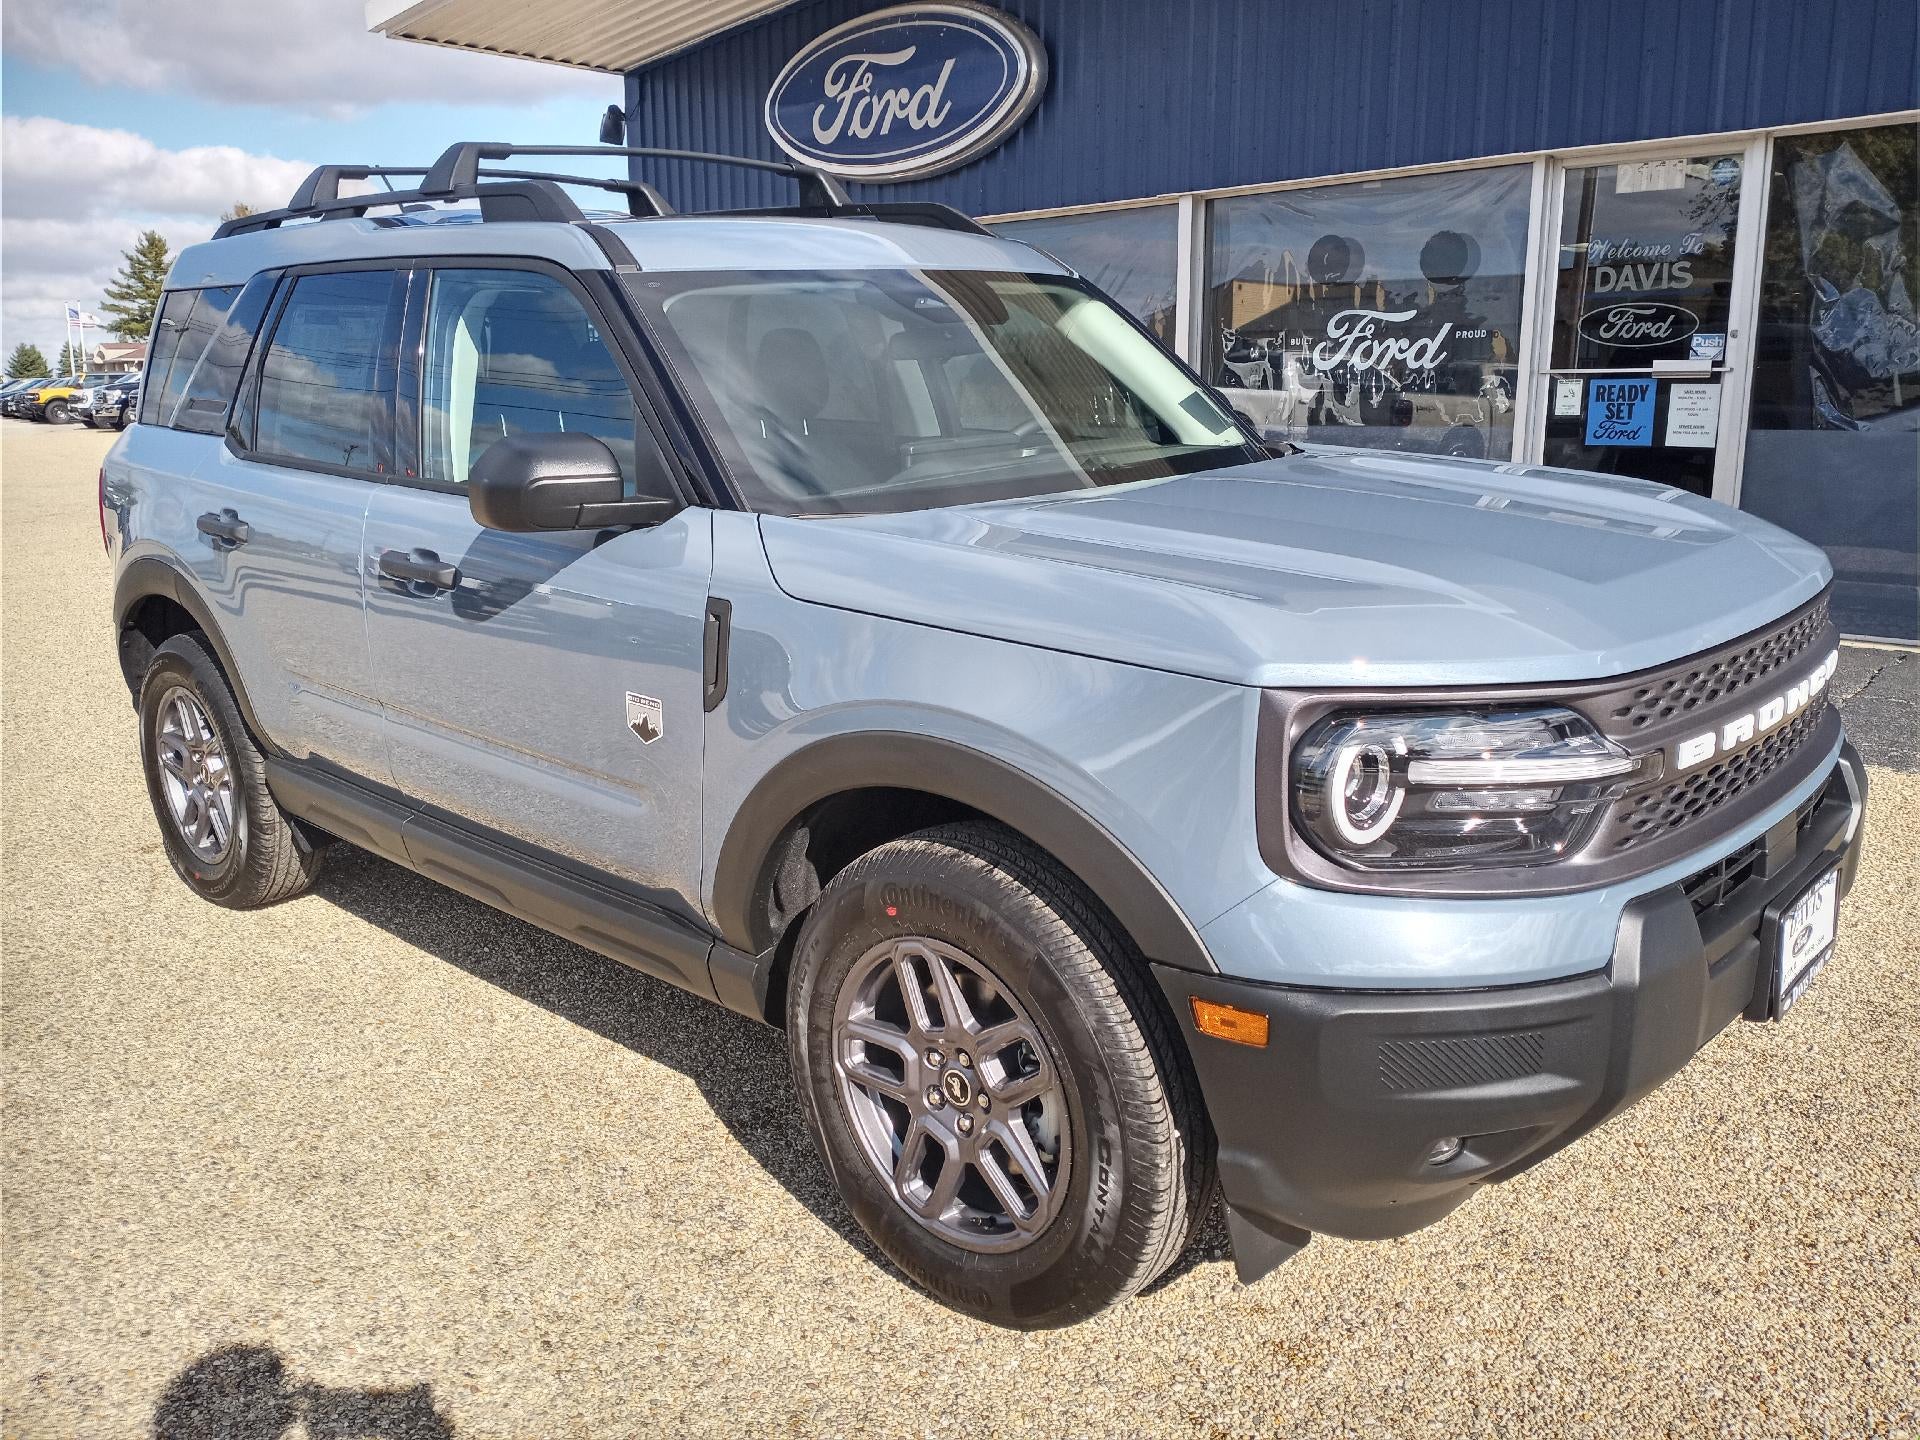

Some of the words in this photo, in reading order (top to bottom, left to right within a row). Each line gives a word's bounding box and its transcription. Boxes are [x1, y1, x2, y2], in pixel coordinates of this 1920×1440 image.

[812, 45, 956, 145] Ford
[1587, 239, 1672, 260] Welcome
[1679, 232, 1705, 255] To
[1594, 261, 1694, 293] DAVIS
[1600, 307, 1676, 339] Ford
[1312, 309, 1453, 371] Ford
[1455, 330, 1487, 339] PROUD
[1691, 336, 1723, 348] Push
[1595, 383, 1650, 403] READY
[1605, 402, 1635, 421] SET
[1592, 420, 1640, 441] Ford
[1678, 650, 1838, 770] BRONCO
